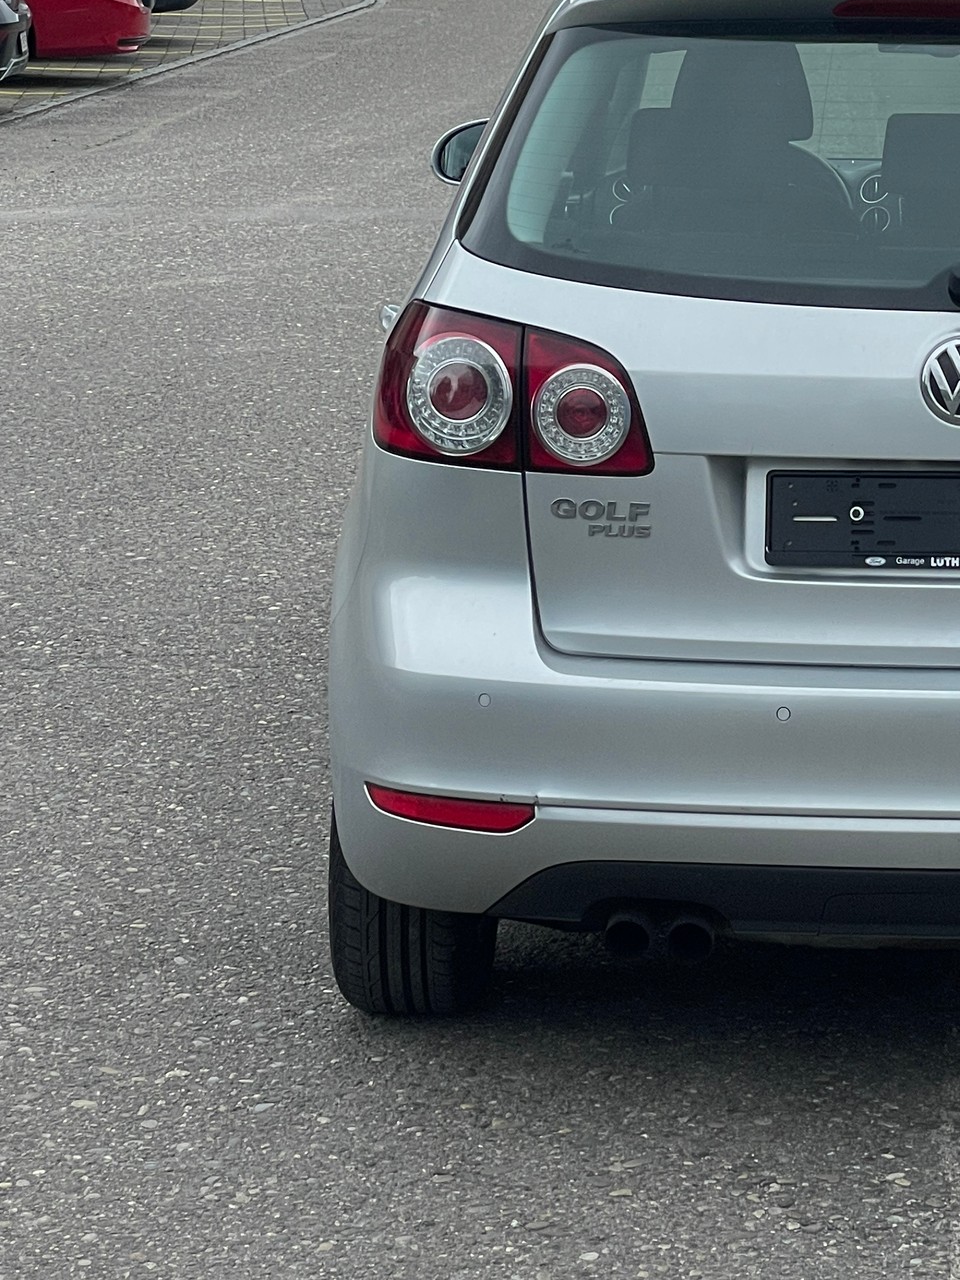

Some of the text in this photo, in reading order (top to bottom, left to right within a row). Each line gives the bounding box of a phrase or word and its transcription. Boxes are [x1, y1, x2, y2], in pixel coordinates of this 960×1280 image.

[550, 497, 651, 522] GOLF
[588, 523, 652, 538] PLUS
[895, 556, 925, 566] Garage
